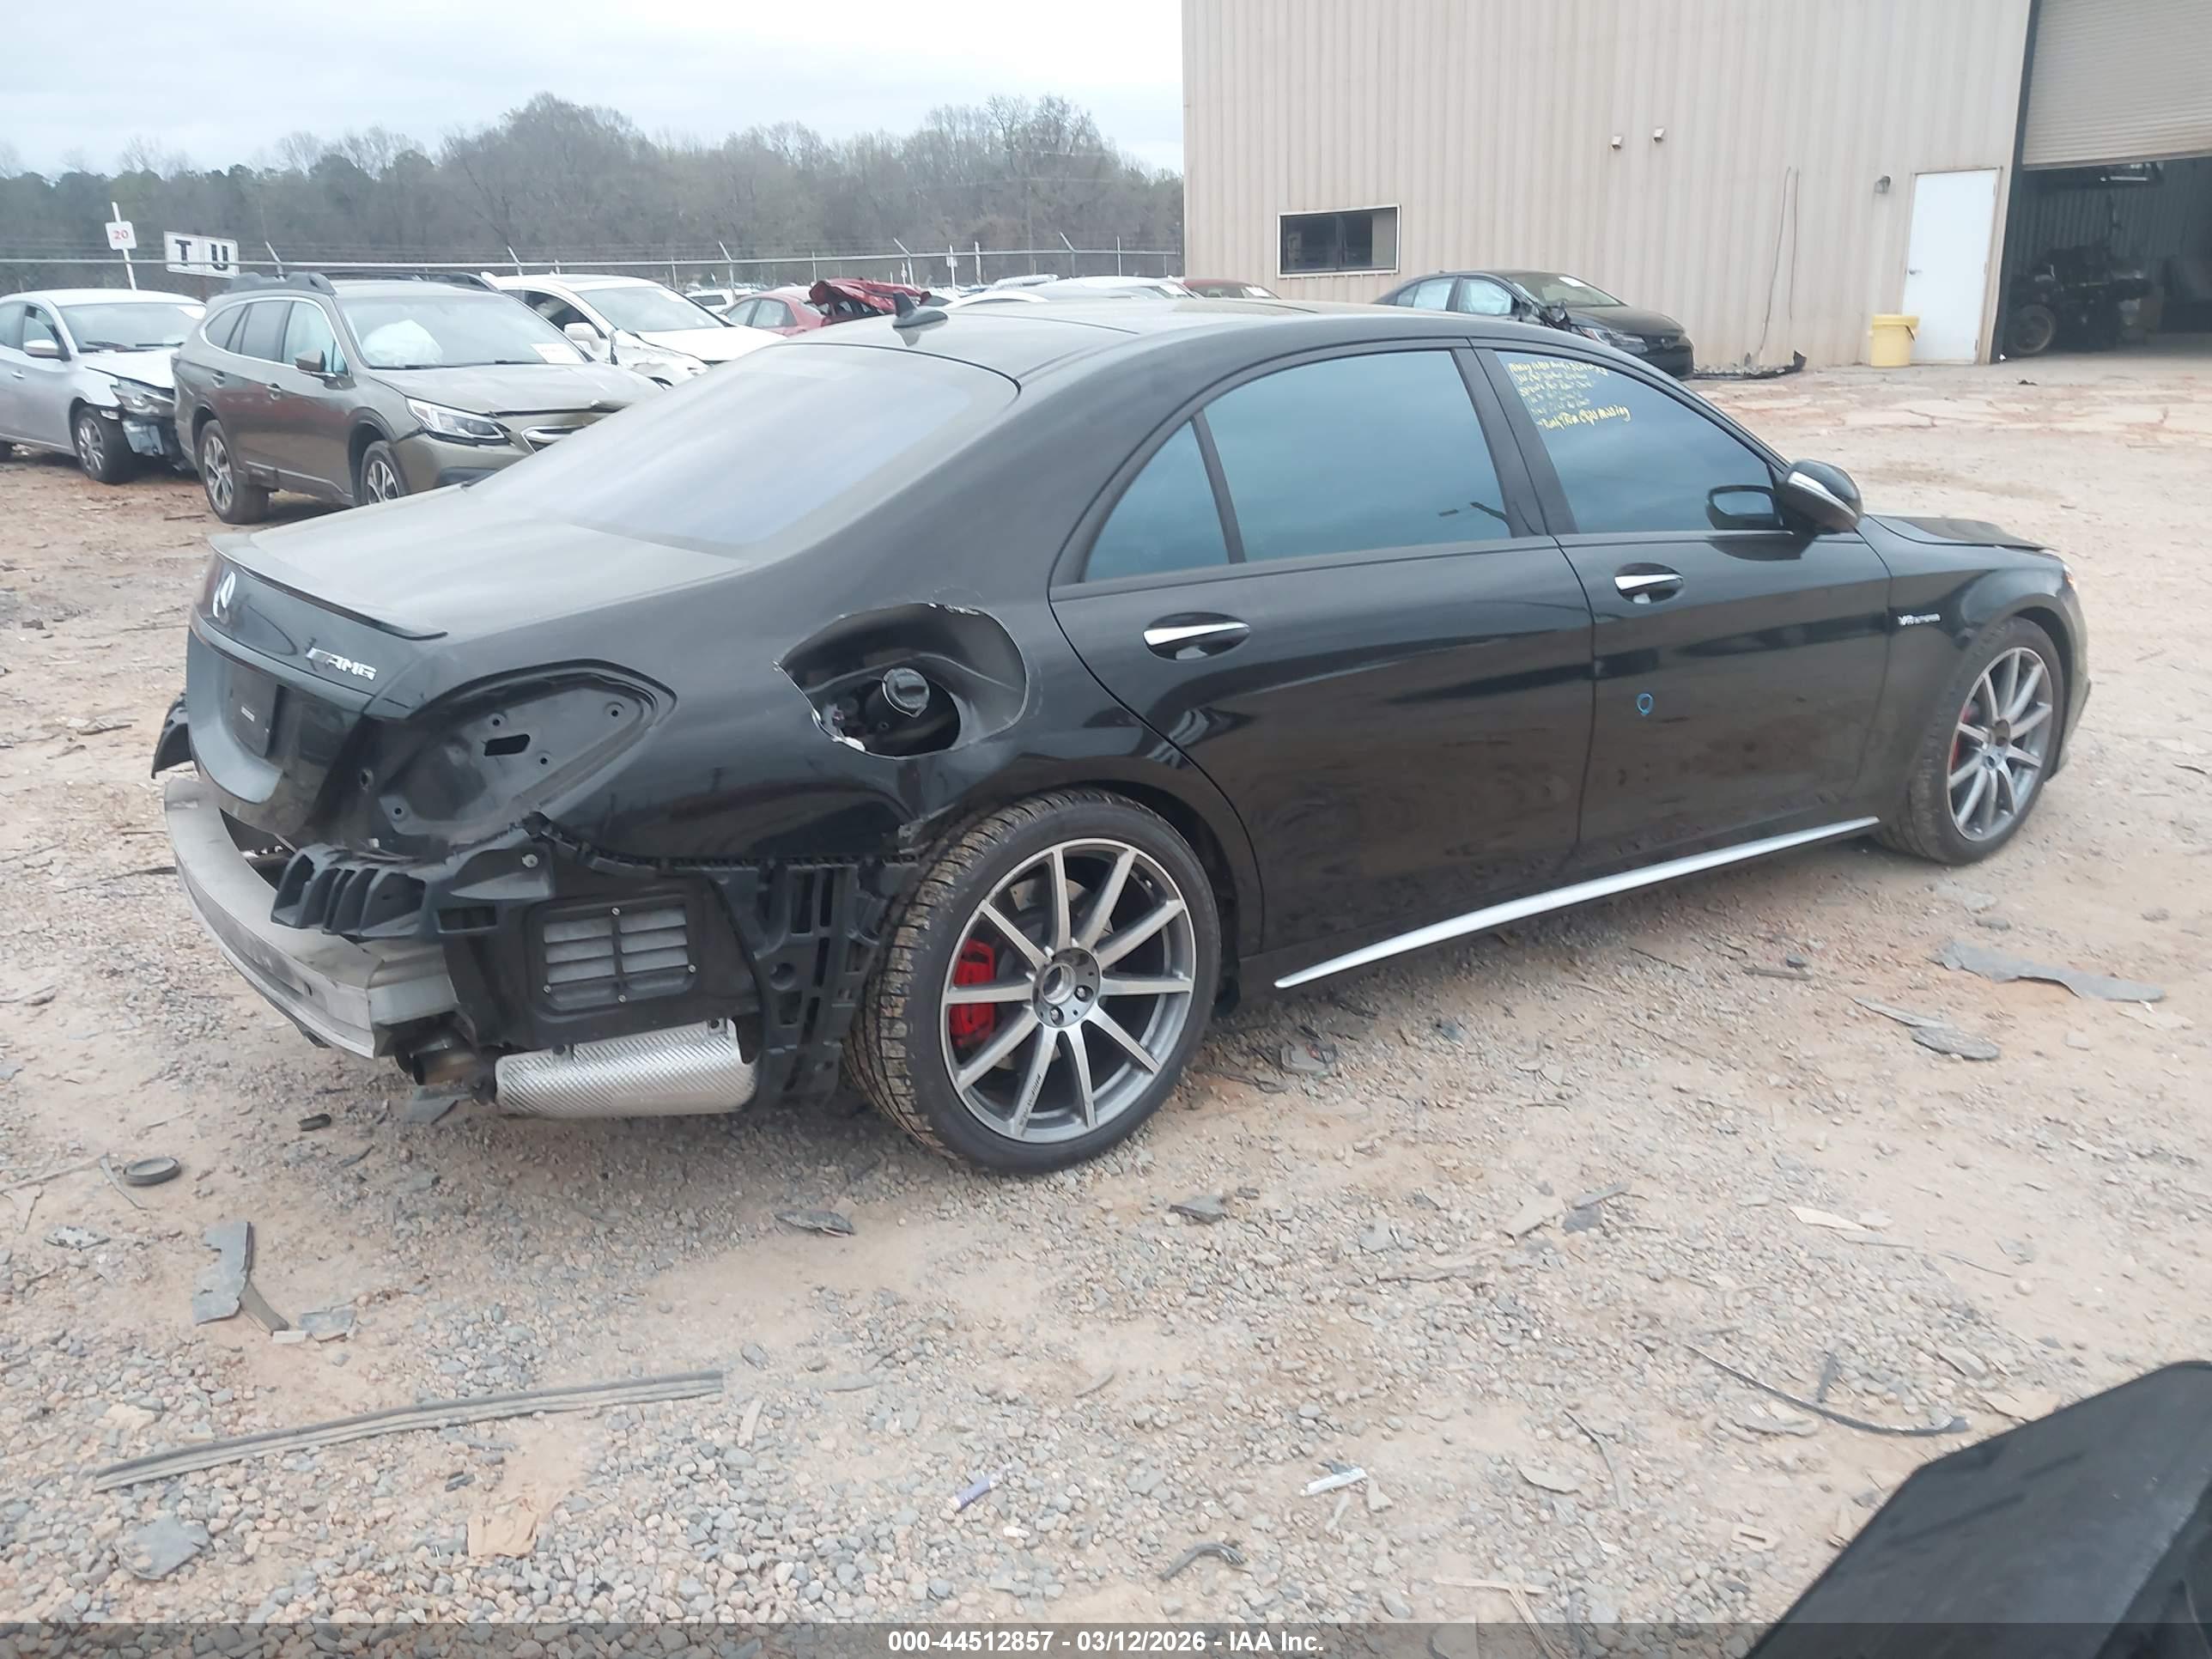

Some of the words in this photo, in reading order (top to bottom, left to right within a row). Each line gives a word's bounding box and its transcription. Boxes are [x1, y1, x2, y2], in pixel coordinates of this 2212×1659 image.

[113, 229, 129, 240] 20
[174, 239, 192, 267] T
[210, 243, 229, 271] U
[325, 653, 378, 681] AMG
